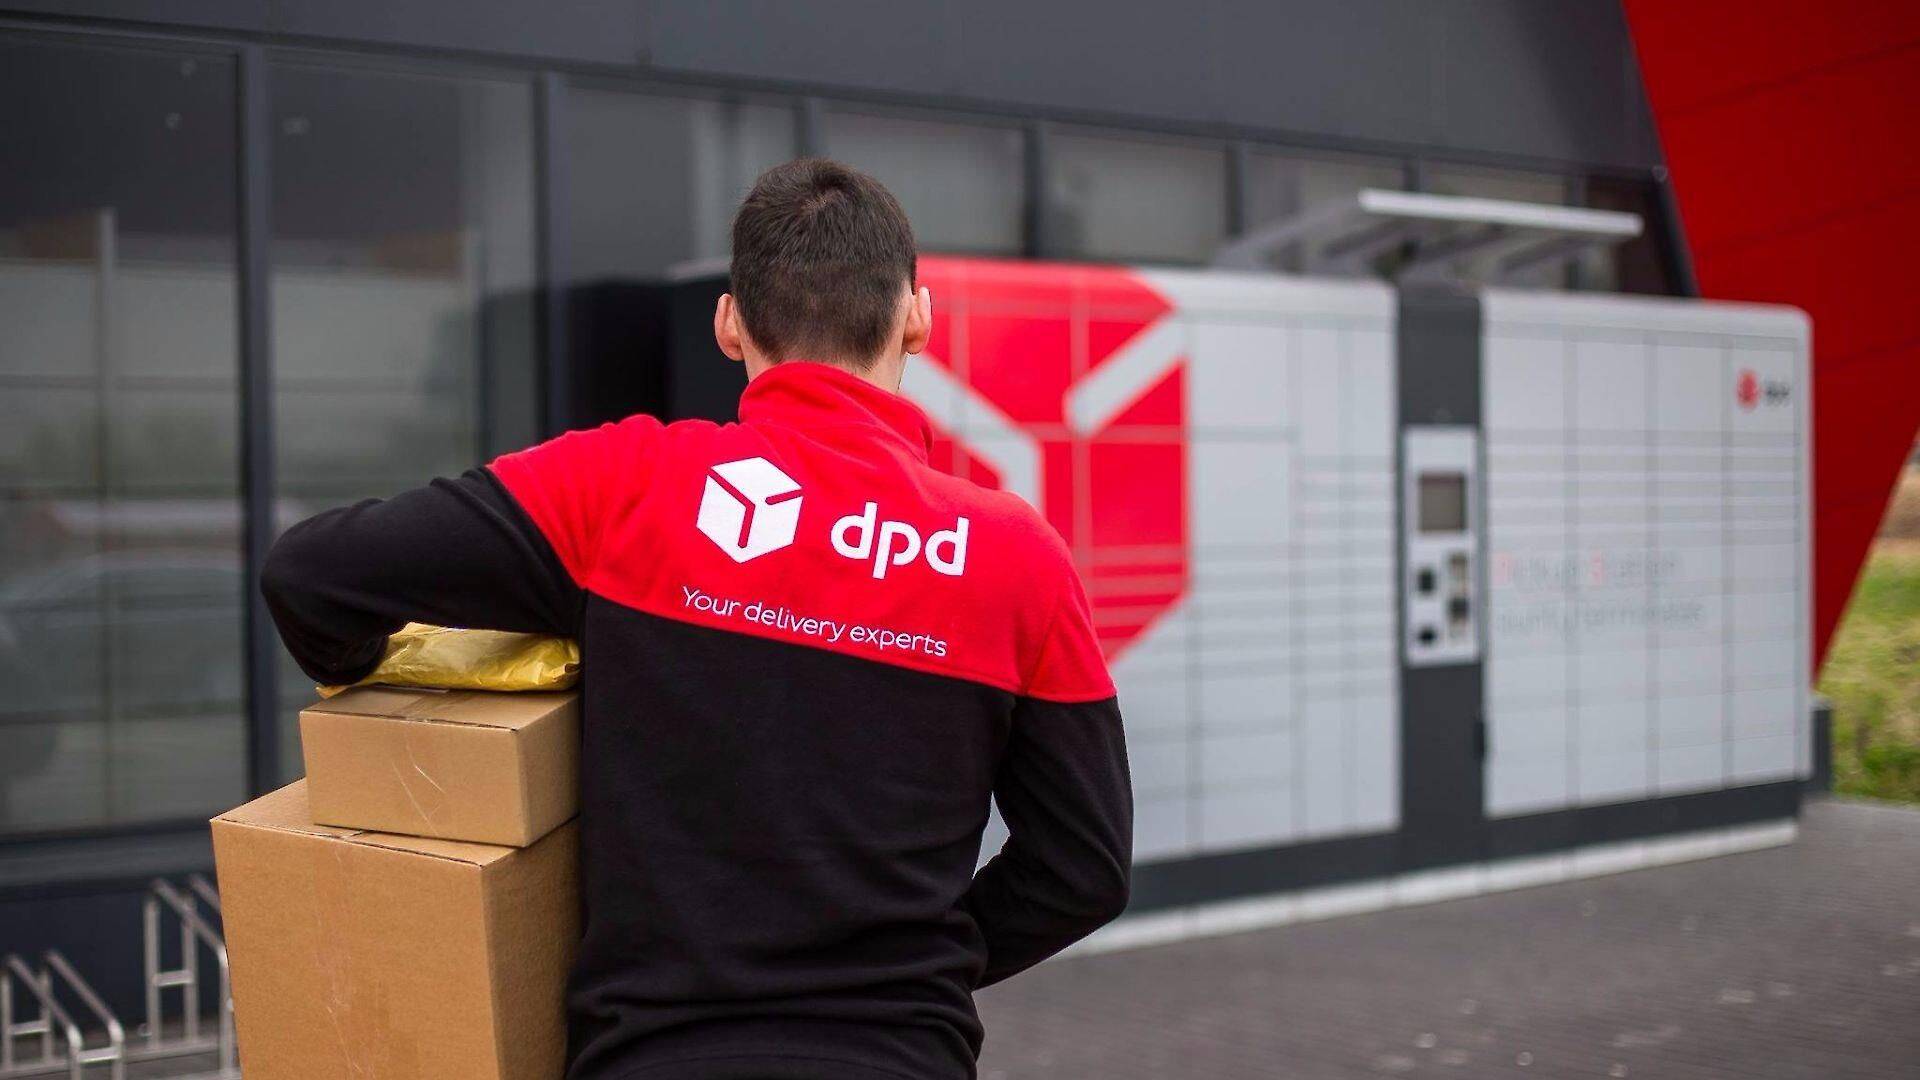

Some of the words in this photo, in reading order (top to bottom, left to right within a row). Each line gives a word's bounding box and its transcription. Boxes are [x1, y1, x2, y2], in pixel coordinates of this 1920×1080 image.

[830, 501, 970, 580] dpd
[683, 586, 741, 616] Your
[743, 601, 846, 642] delivery
[849, 625, 947, 657] experts
